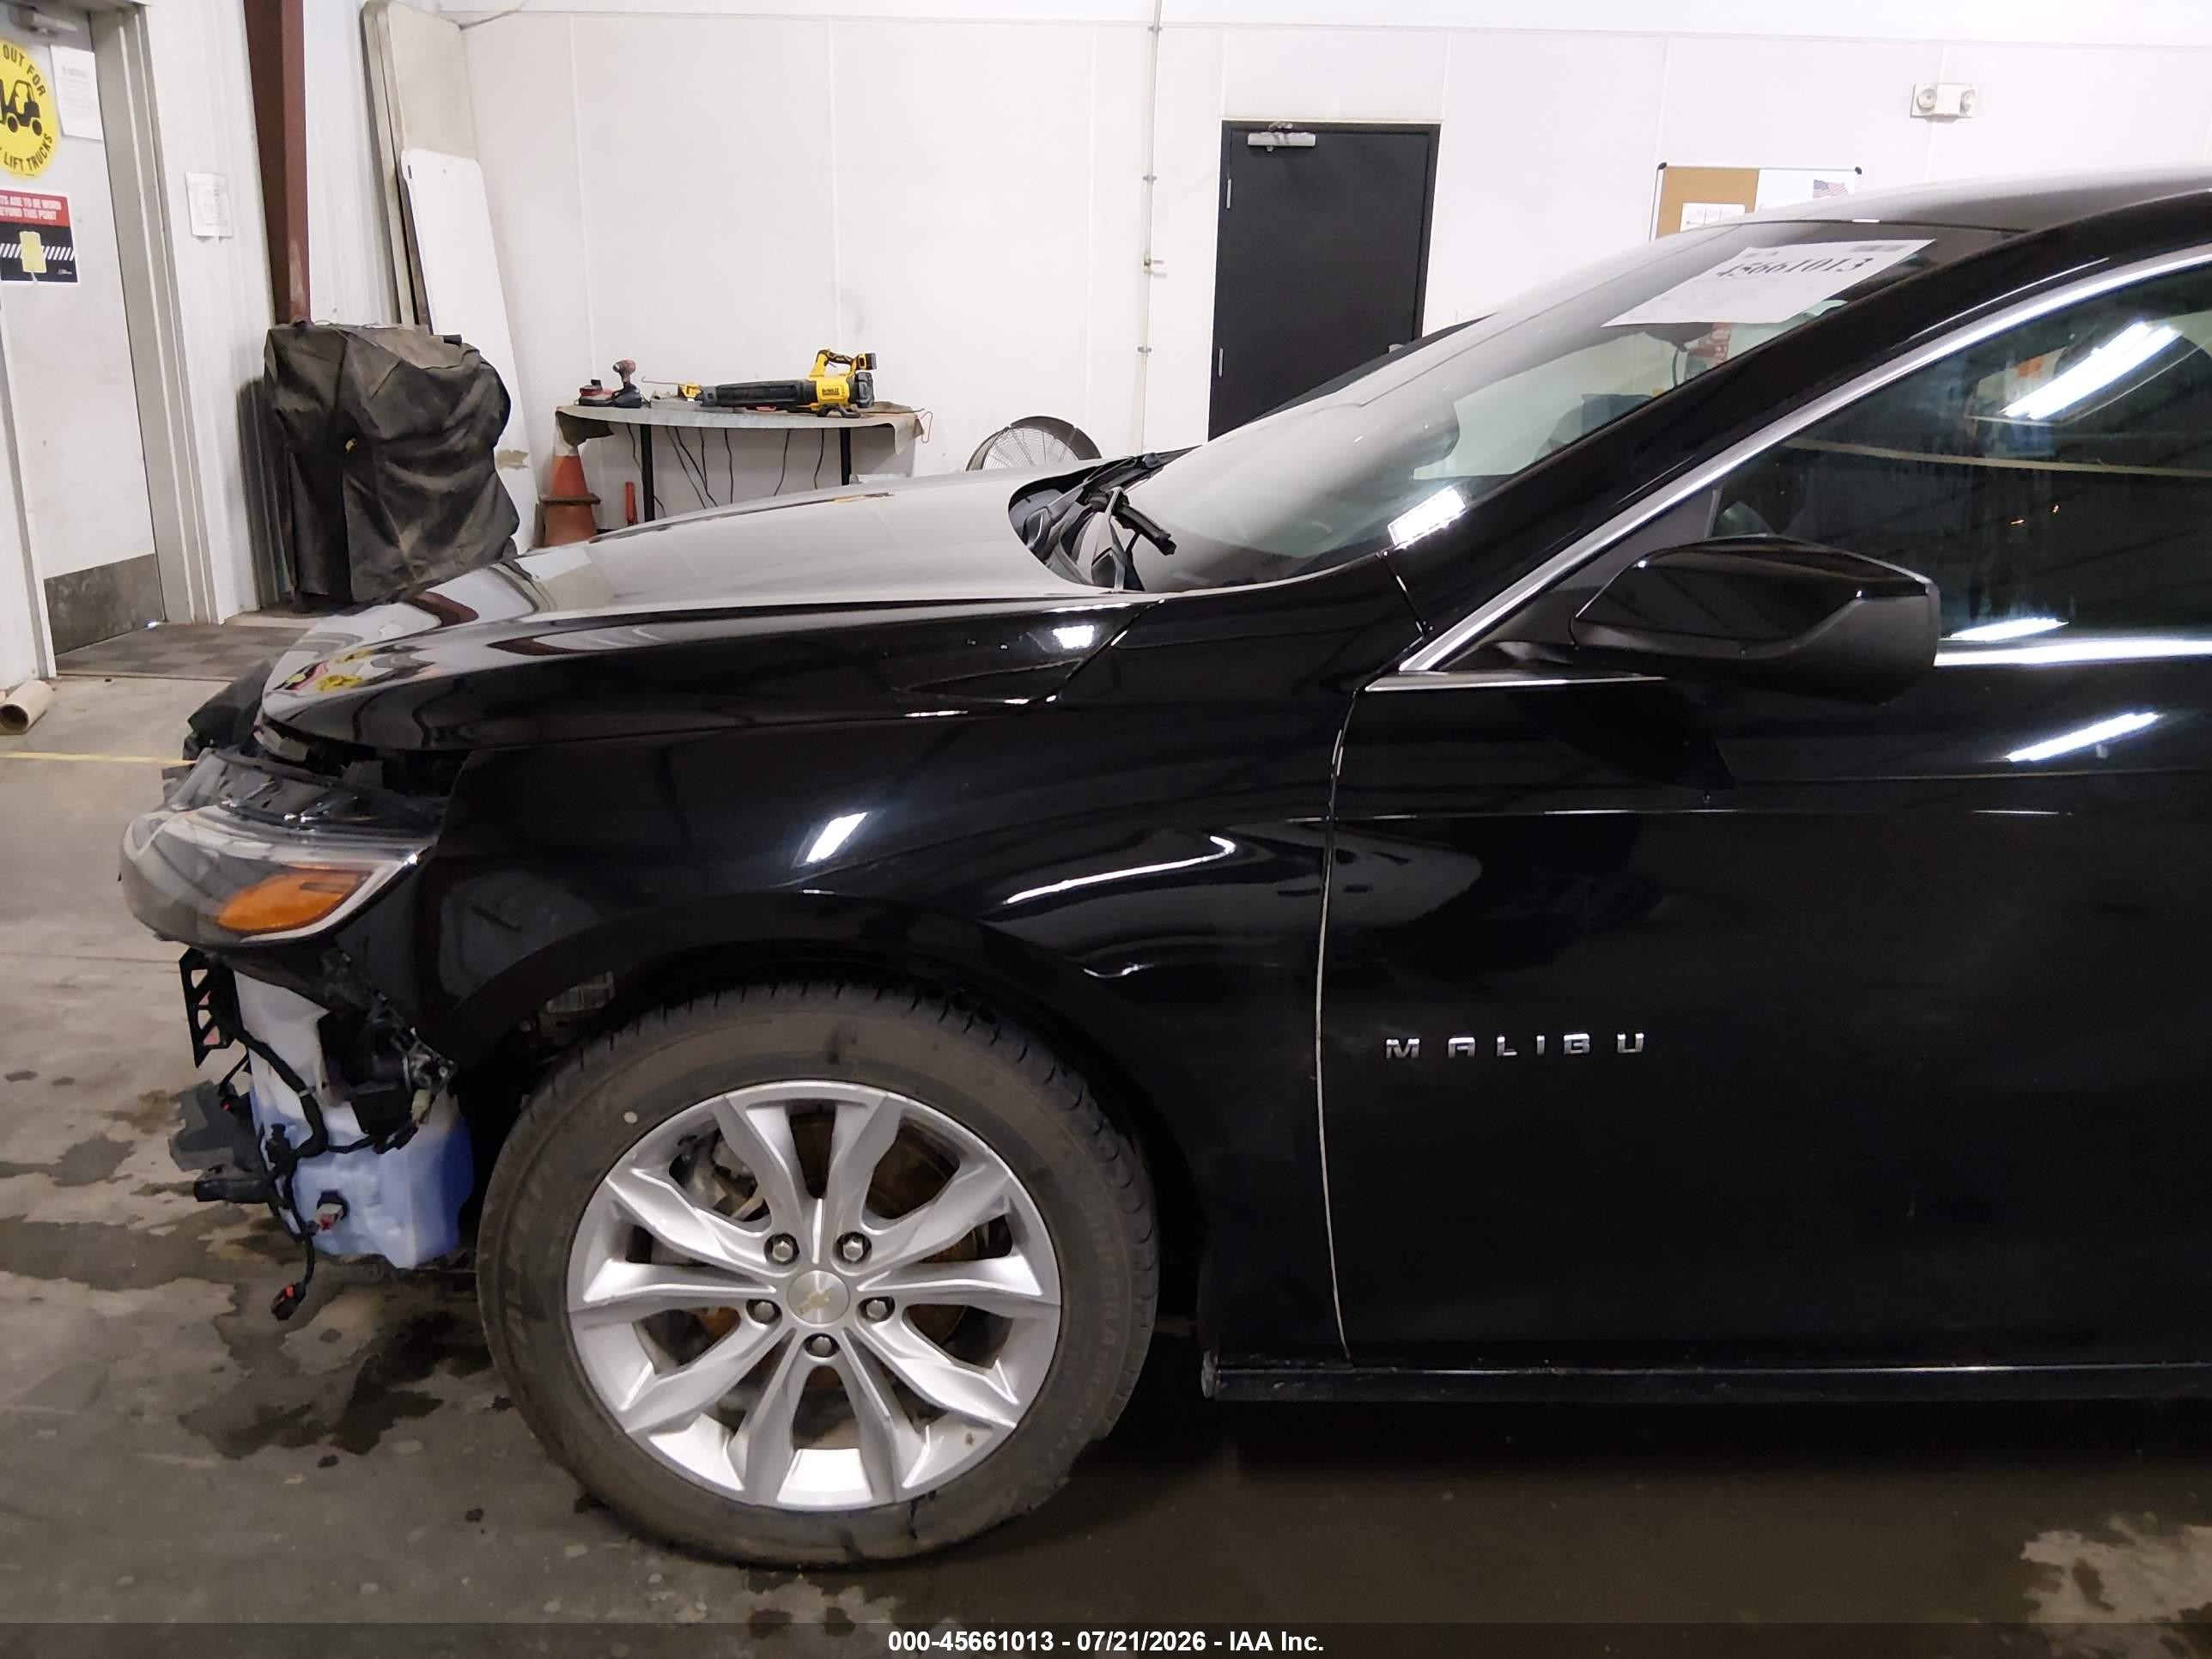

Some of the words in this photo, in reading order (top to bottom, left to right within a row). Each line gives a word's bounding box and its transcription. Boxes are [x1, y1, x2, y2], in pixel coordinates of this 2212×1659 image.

[3, 44, 25, 67] OUT
[27, 64, 46, 97] FOR
[3, 151, 24, 172] LIFT
[26, 133, 53, 171] TRUCKS
[0, 195, 9, 205] TS
[23, 198, 32, 208] TO
[0, 206, 22, 217] EYOND
[38, 210, 57, 220] POINT
[1385, 1032, 1645, 1059] MALIBU
